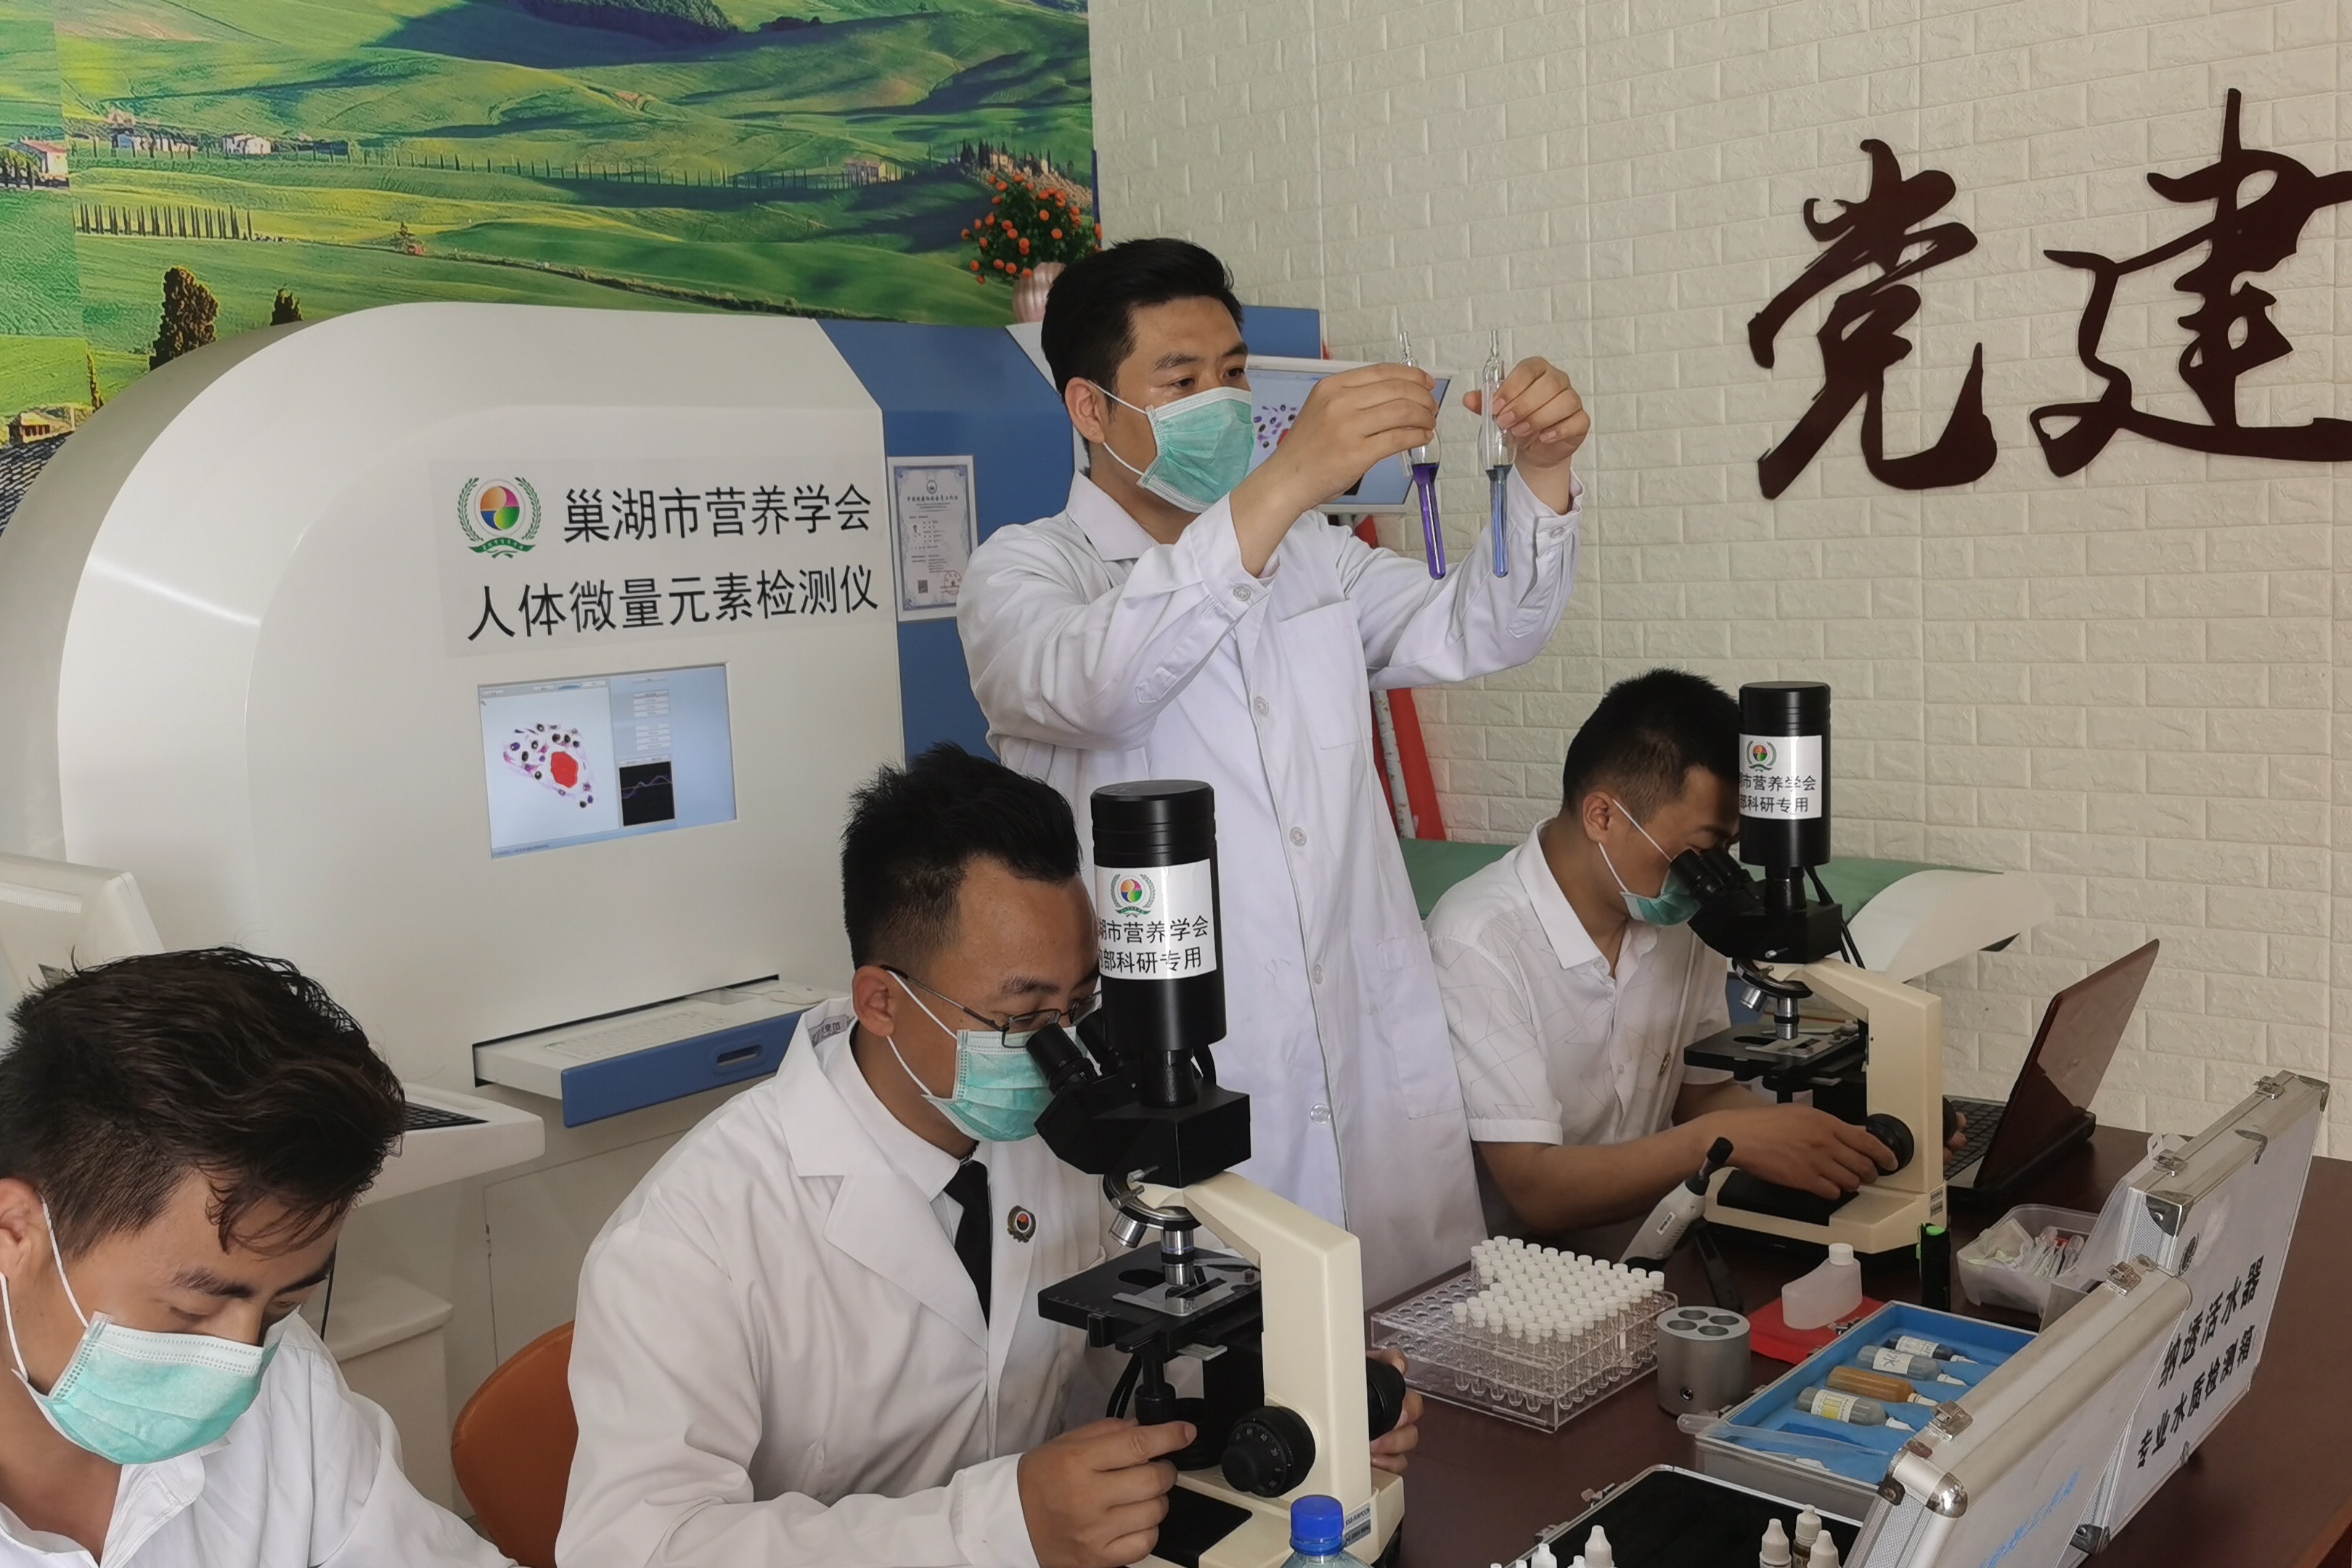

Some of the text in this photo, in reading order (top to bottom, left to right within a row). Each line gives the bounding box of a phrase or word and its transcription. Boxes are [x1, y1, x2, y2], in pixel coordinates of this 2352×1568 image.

[564, 483, 872, 544] 巢湖市营养学会
[467, 564, 879, 642] 人体微量元素检测仪
[1740, 772, 1816, 793] 市营养学会
